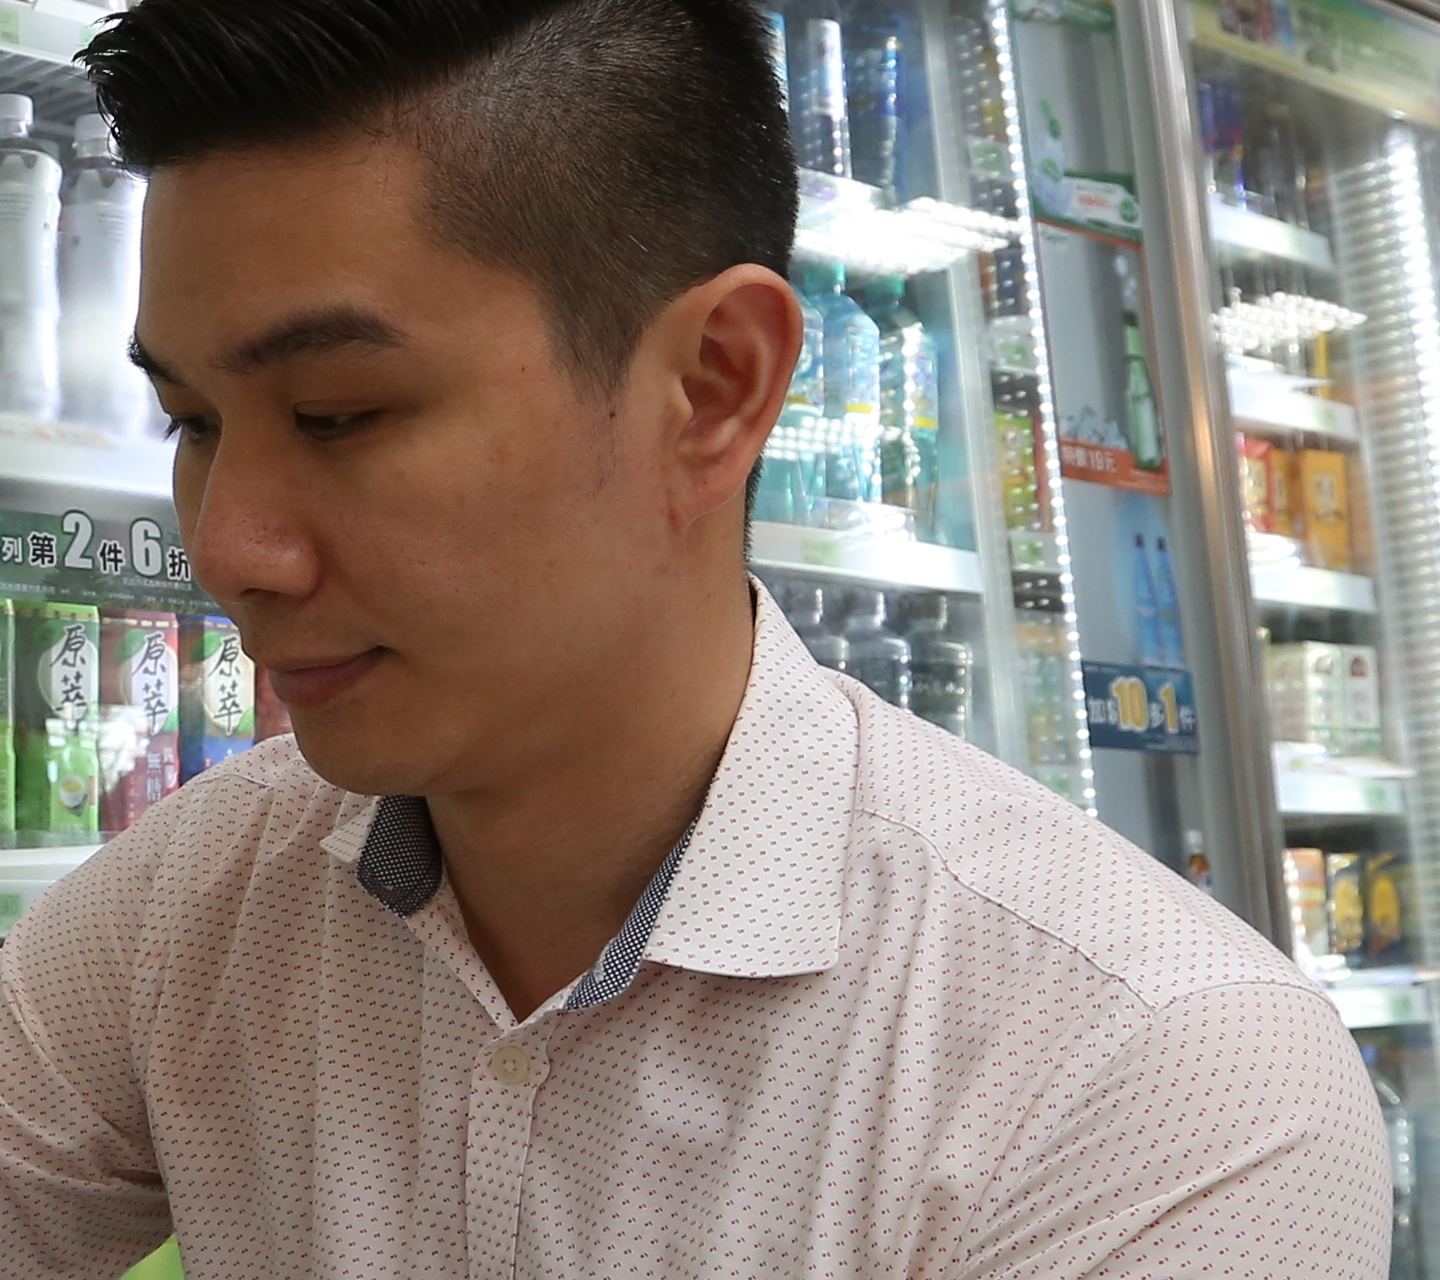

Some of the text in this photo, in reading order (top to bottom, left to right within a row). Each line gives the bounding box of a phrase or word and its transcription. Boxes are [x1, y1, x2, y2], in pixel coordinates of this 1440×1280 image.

[49, 623, 91, 730] 原萃
[130, 632, 171, 736] 原萃
[207, 634, 244, 736] 原萃
